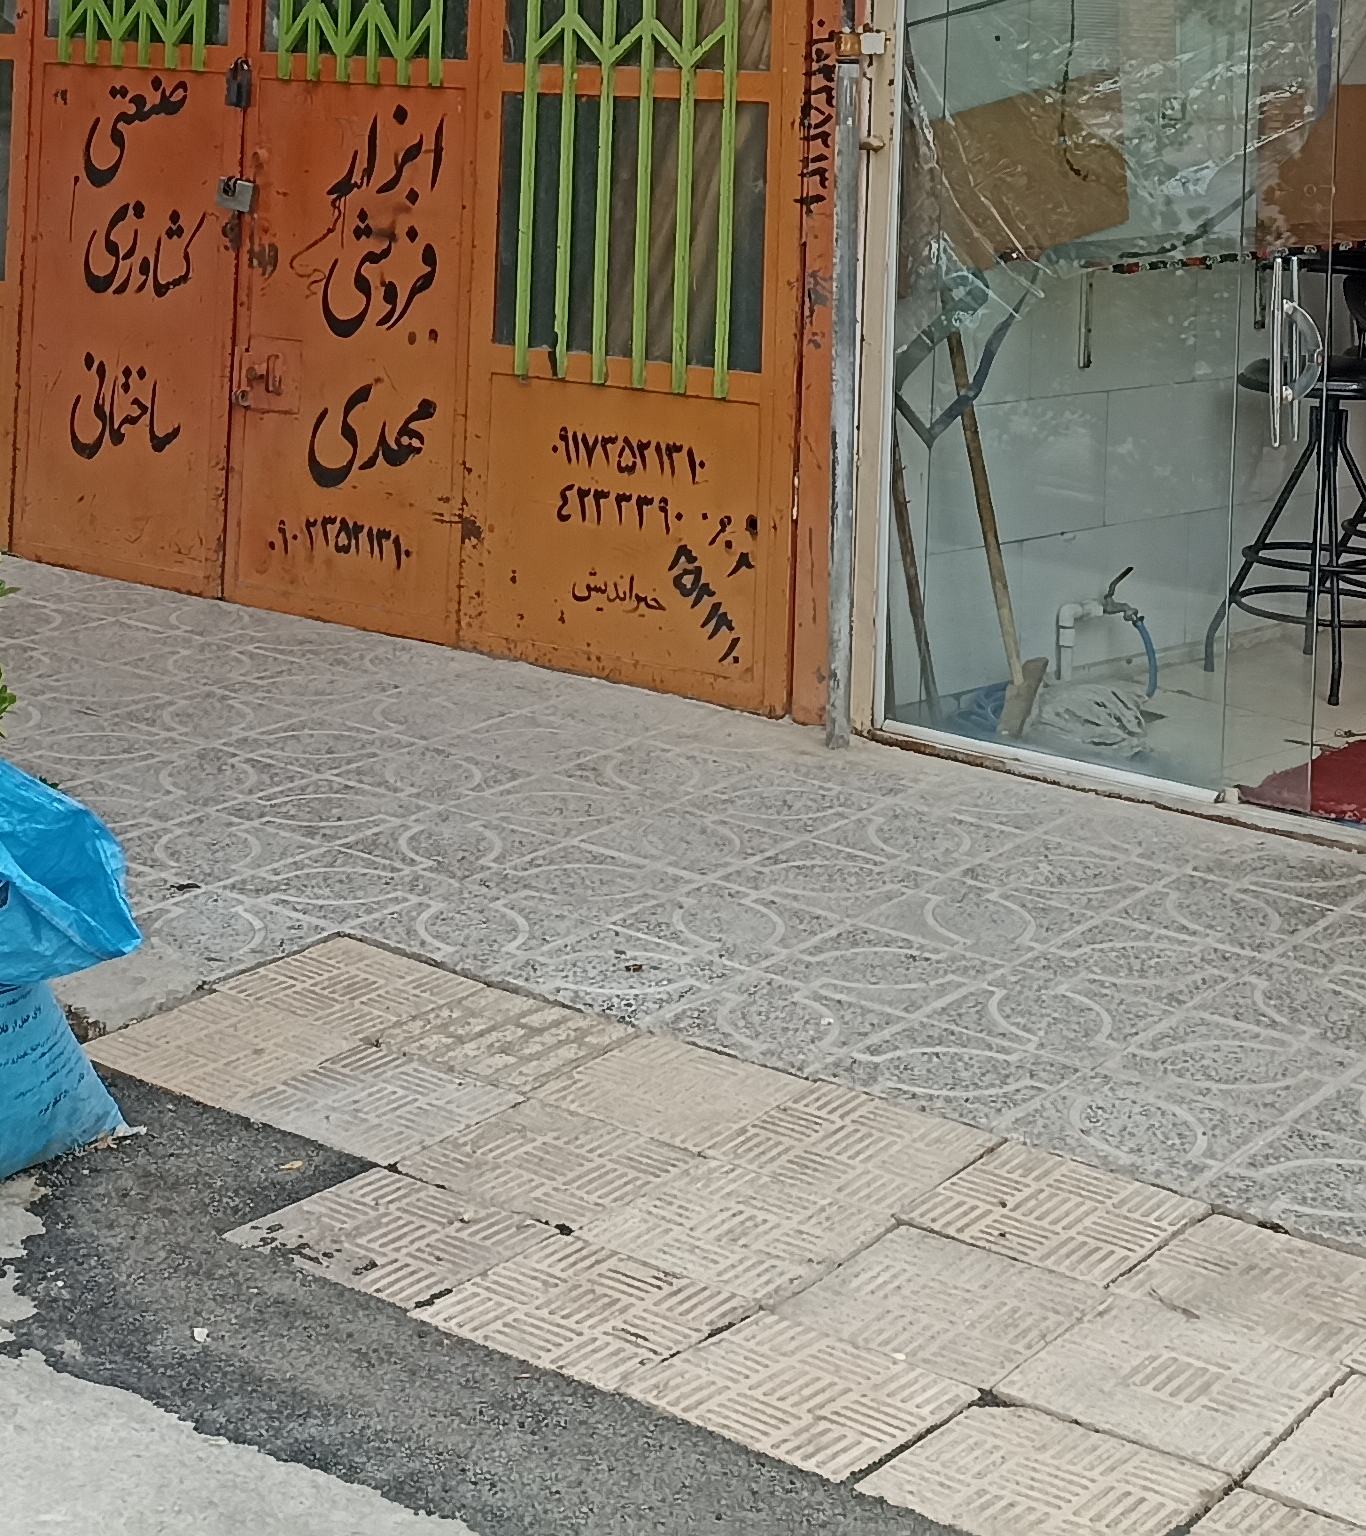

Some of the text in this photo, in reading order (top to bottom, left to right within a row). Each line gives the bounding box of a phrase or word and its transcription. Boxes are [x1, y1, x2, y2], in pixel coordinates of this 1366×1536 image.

[83, 75, 190, 189] صنعتی
[327, 104, 445, 205] ابزار
[84, 201, 208, 299] کشاورزی
[322, 207, 438, 339] فروشی
[69, 350, 182, 460] ساختمانی
[307, 381, 439, 489] مهدی
